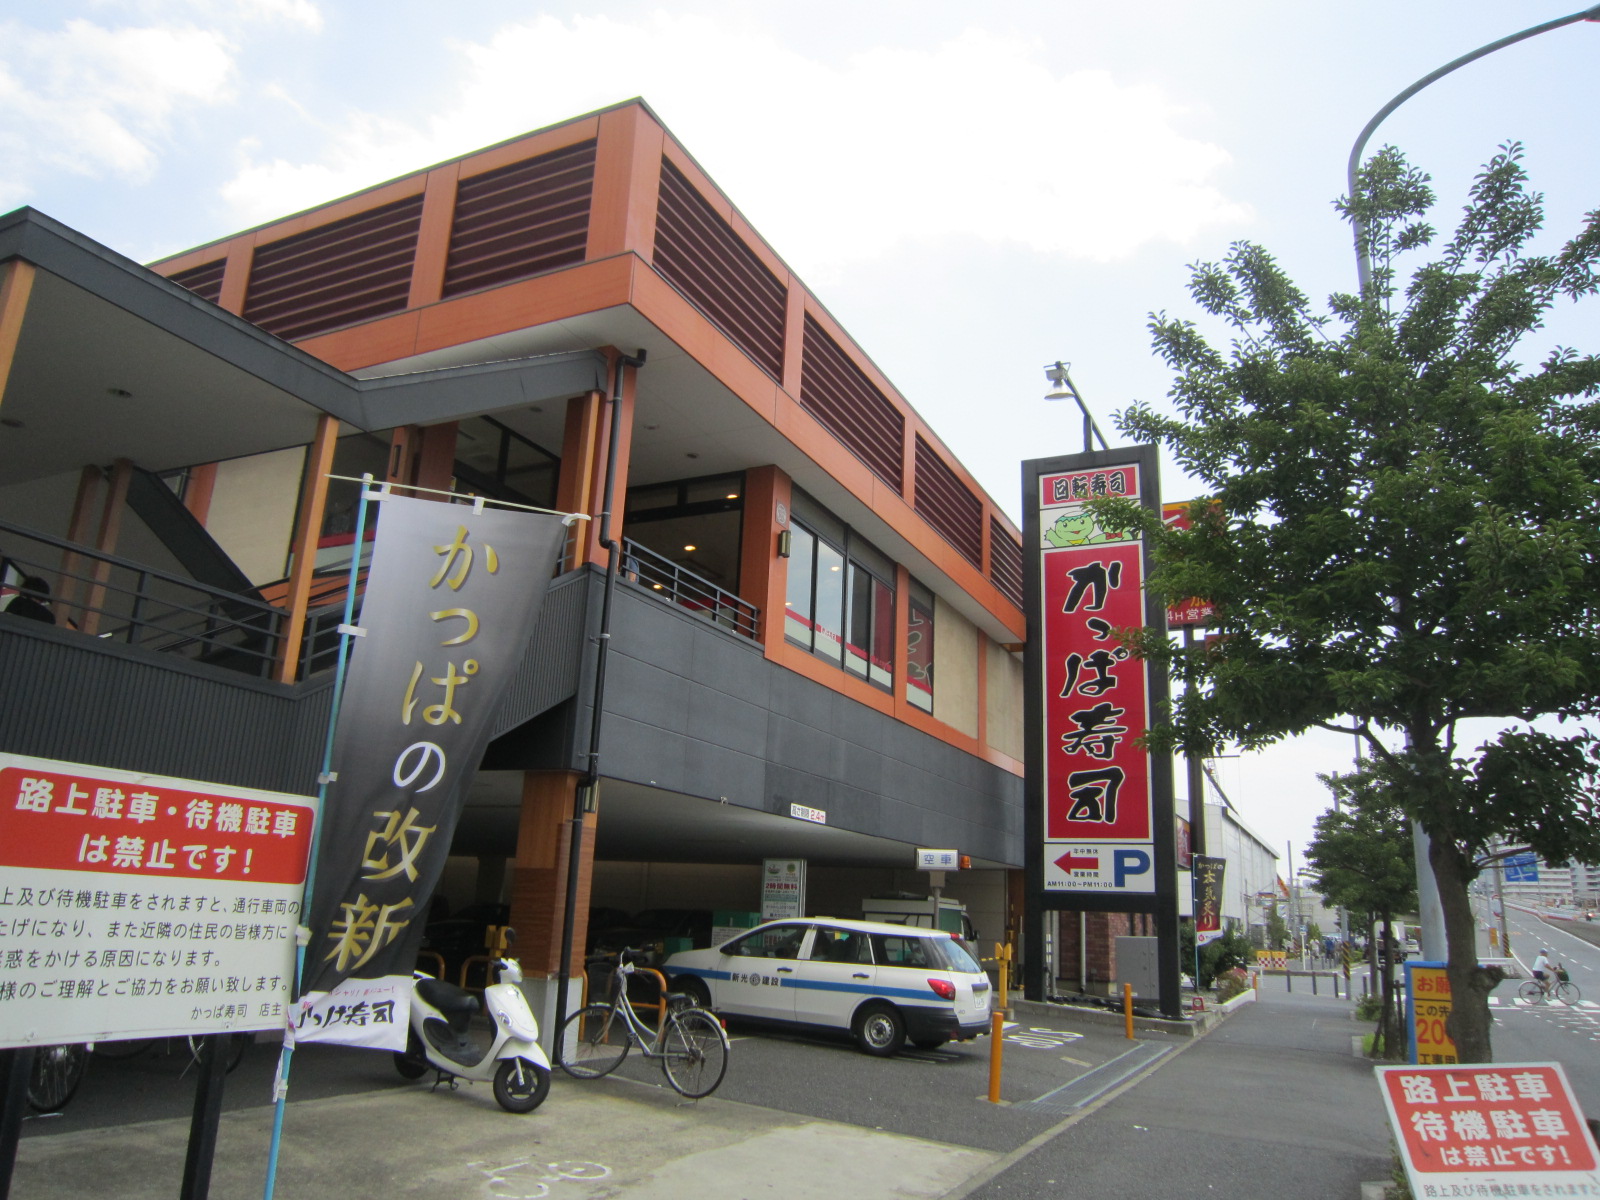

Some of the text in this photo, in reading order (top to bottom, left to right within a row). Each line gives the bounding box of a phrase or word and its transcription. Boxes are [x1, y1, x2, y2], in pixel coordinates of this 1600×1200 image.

[1053, 470, 1126, 501] 回転寿司
[1060, 560, 1130, 824] かっぱ寿司
[324, 525, 498, 974] かっぱの改新
[15, 777, 298, 839] 路上駐車・待機駐車
[78, 833, 254, 874] は禁止です！
[924, 854, 952, 865] 空車
[1114, 849, 1151, 888] P
[0, 949, 220, 968] 惑をかける原因になります。
[191, 1002, 282, 1020] かっぱ寿司 店主
[1416, 1018, 1457, 1045] 20
[1399, 1072, 1553, 1104] 路上駐車
[1411, 1108, 1570, 1143] 待機駐車
[1440, 1145, 1571, 1167] は禁止です！
